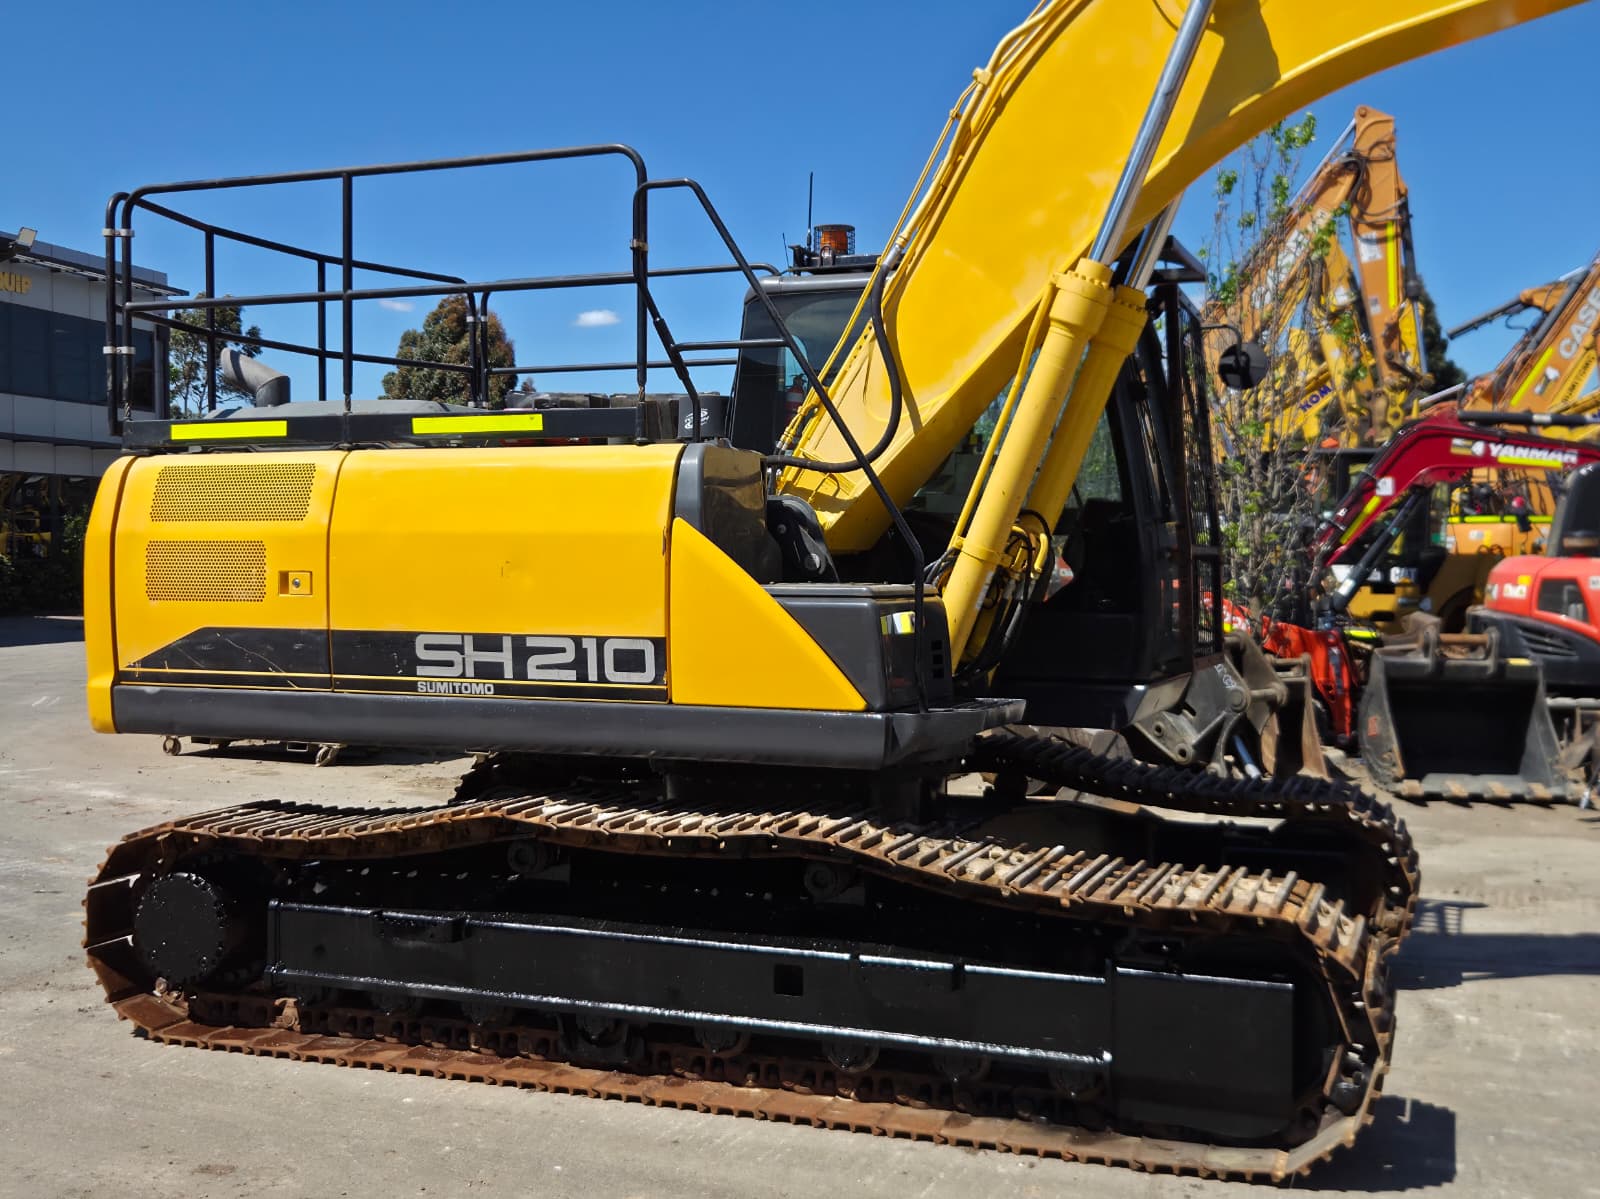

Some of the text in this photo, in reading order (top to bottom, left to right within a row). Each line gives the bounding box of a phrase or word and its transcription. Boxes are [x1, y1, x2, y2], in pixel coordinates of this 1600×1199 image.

[1488, 441, 1578, 464] YANMAR
[415, 633, 656, 683] SH 210
[417, 681, 495, 695] SUMITOMO
